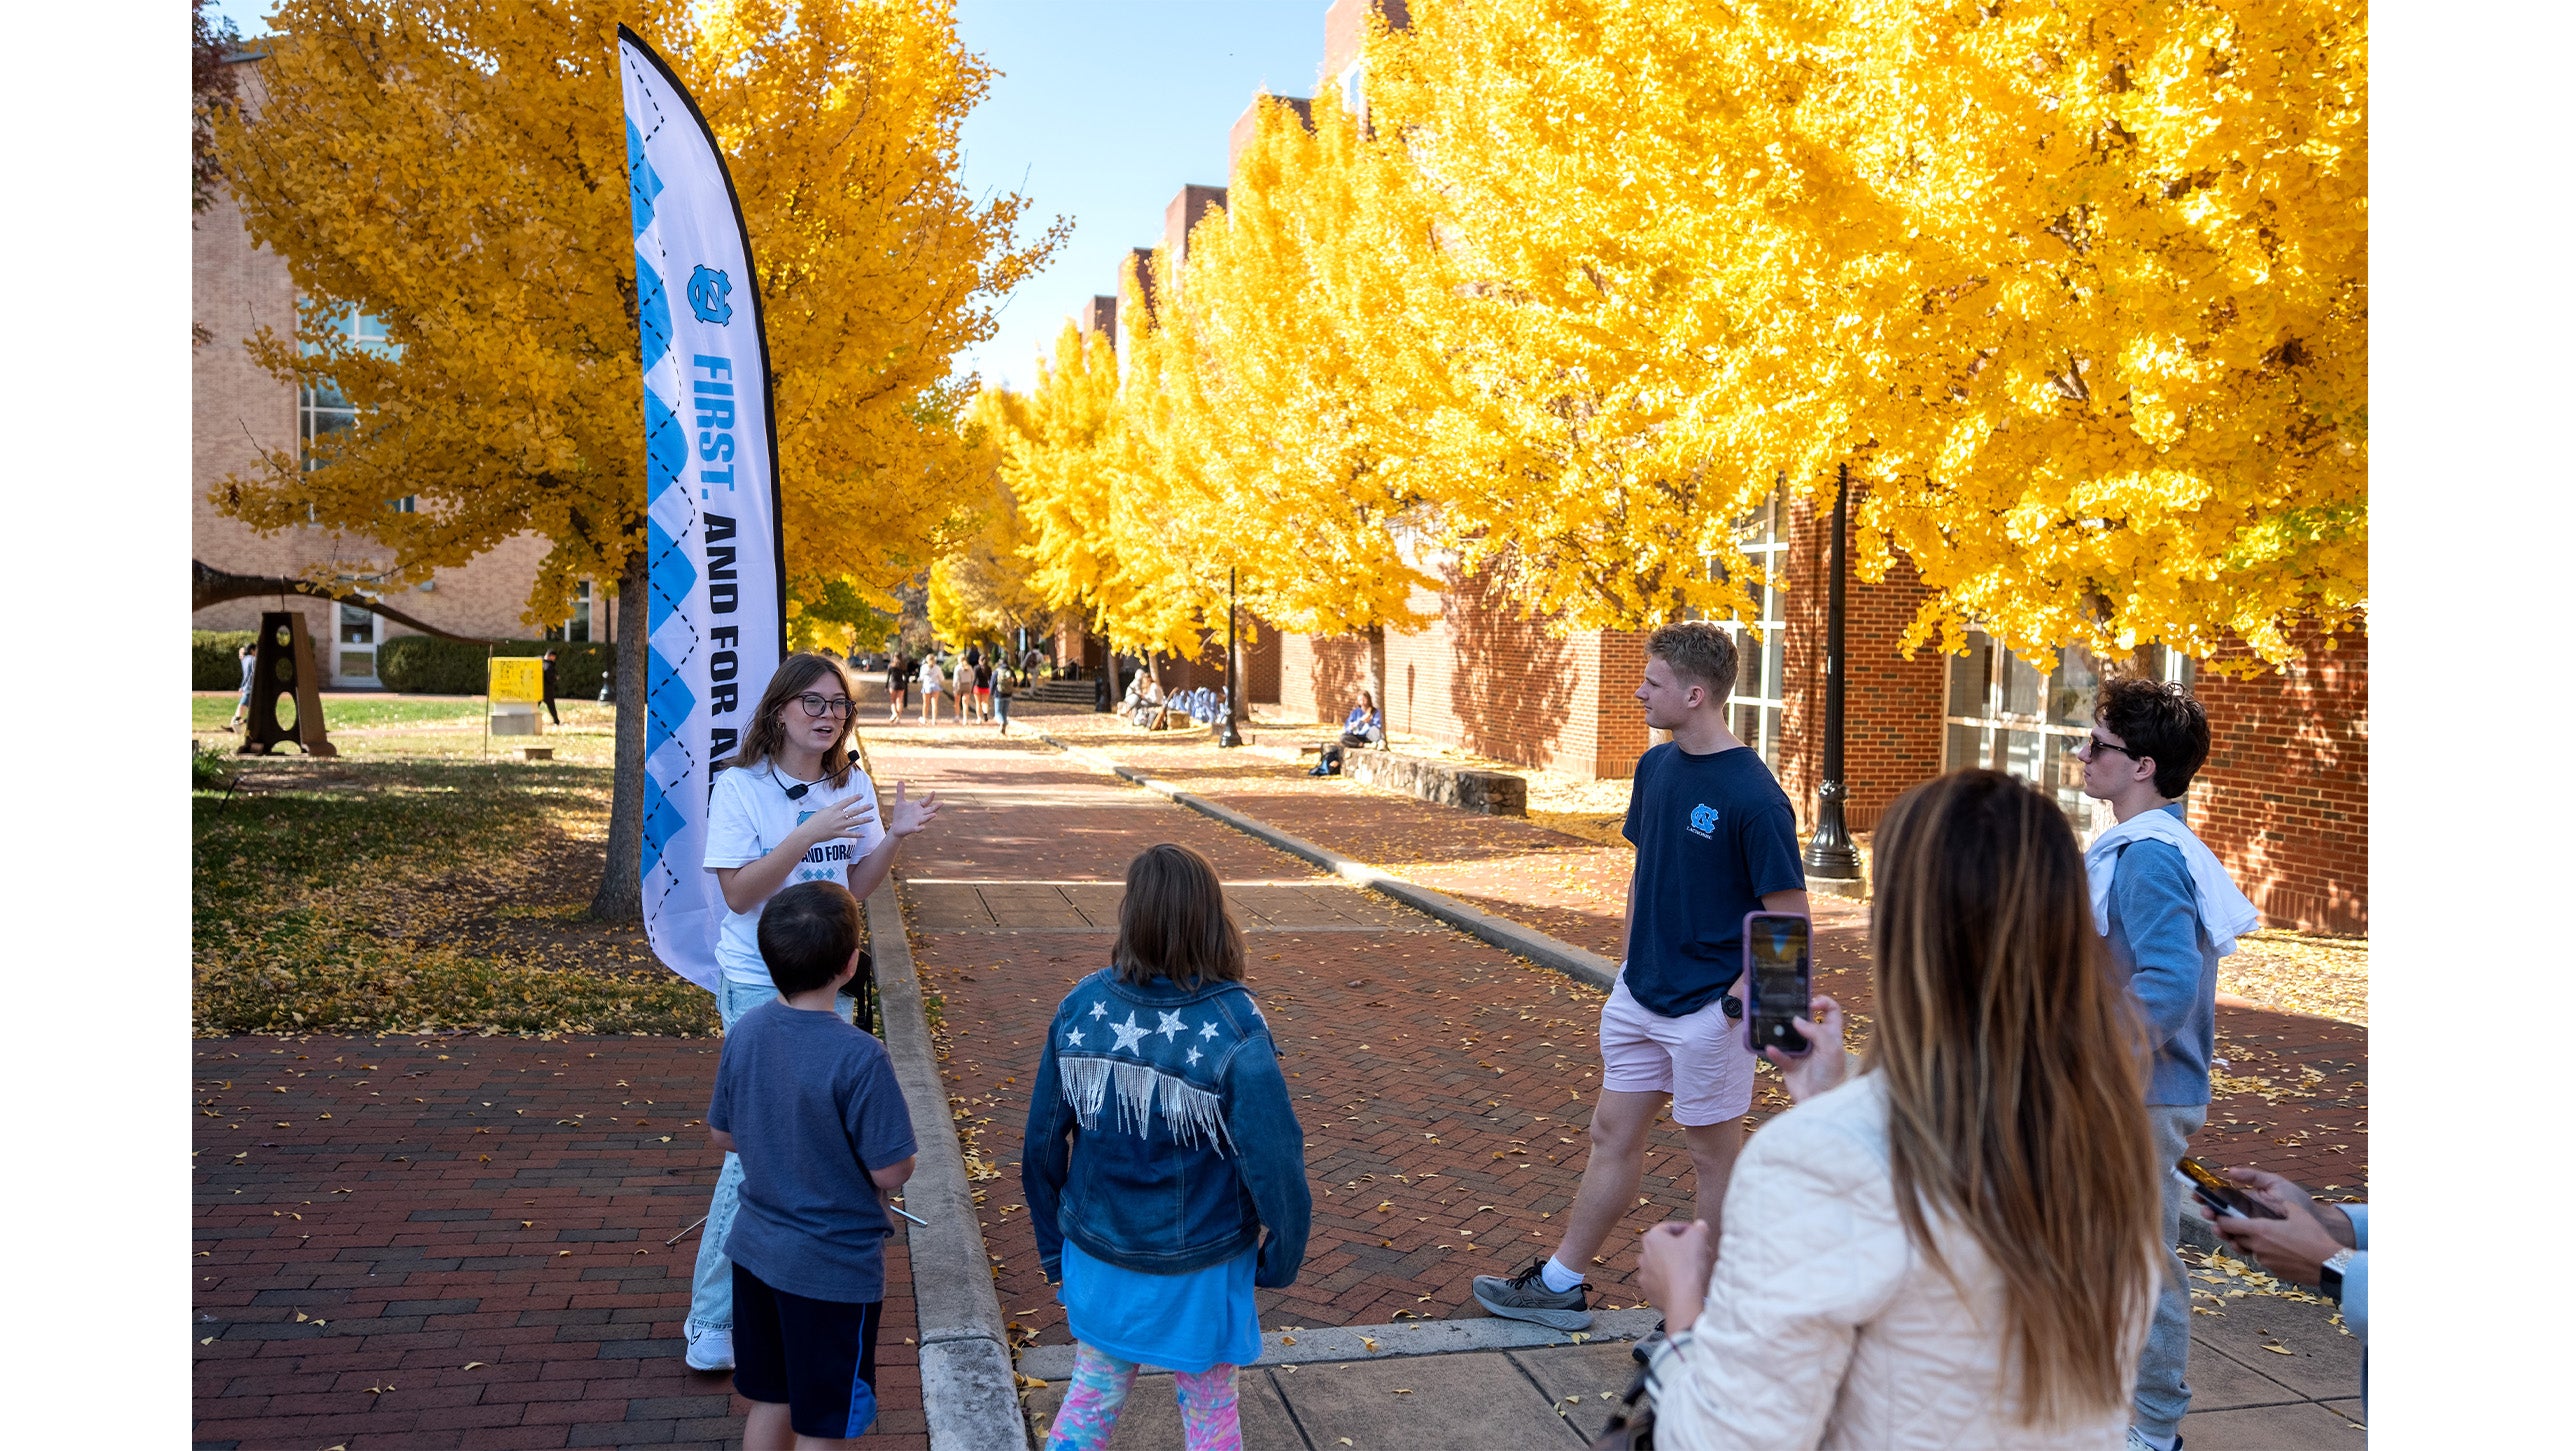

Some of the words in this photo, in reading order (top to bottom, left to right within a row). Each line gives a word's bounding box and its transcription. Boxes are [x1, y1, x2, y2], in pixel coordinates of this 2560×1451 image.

[693, 353, 736, 501] FIRST.
[703, 511, 739, 614] AND
[710, 625, 739, 717] FOR
[825, 844, 848, 862] FOR
